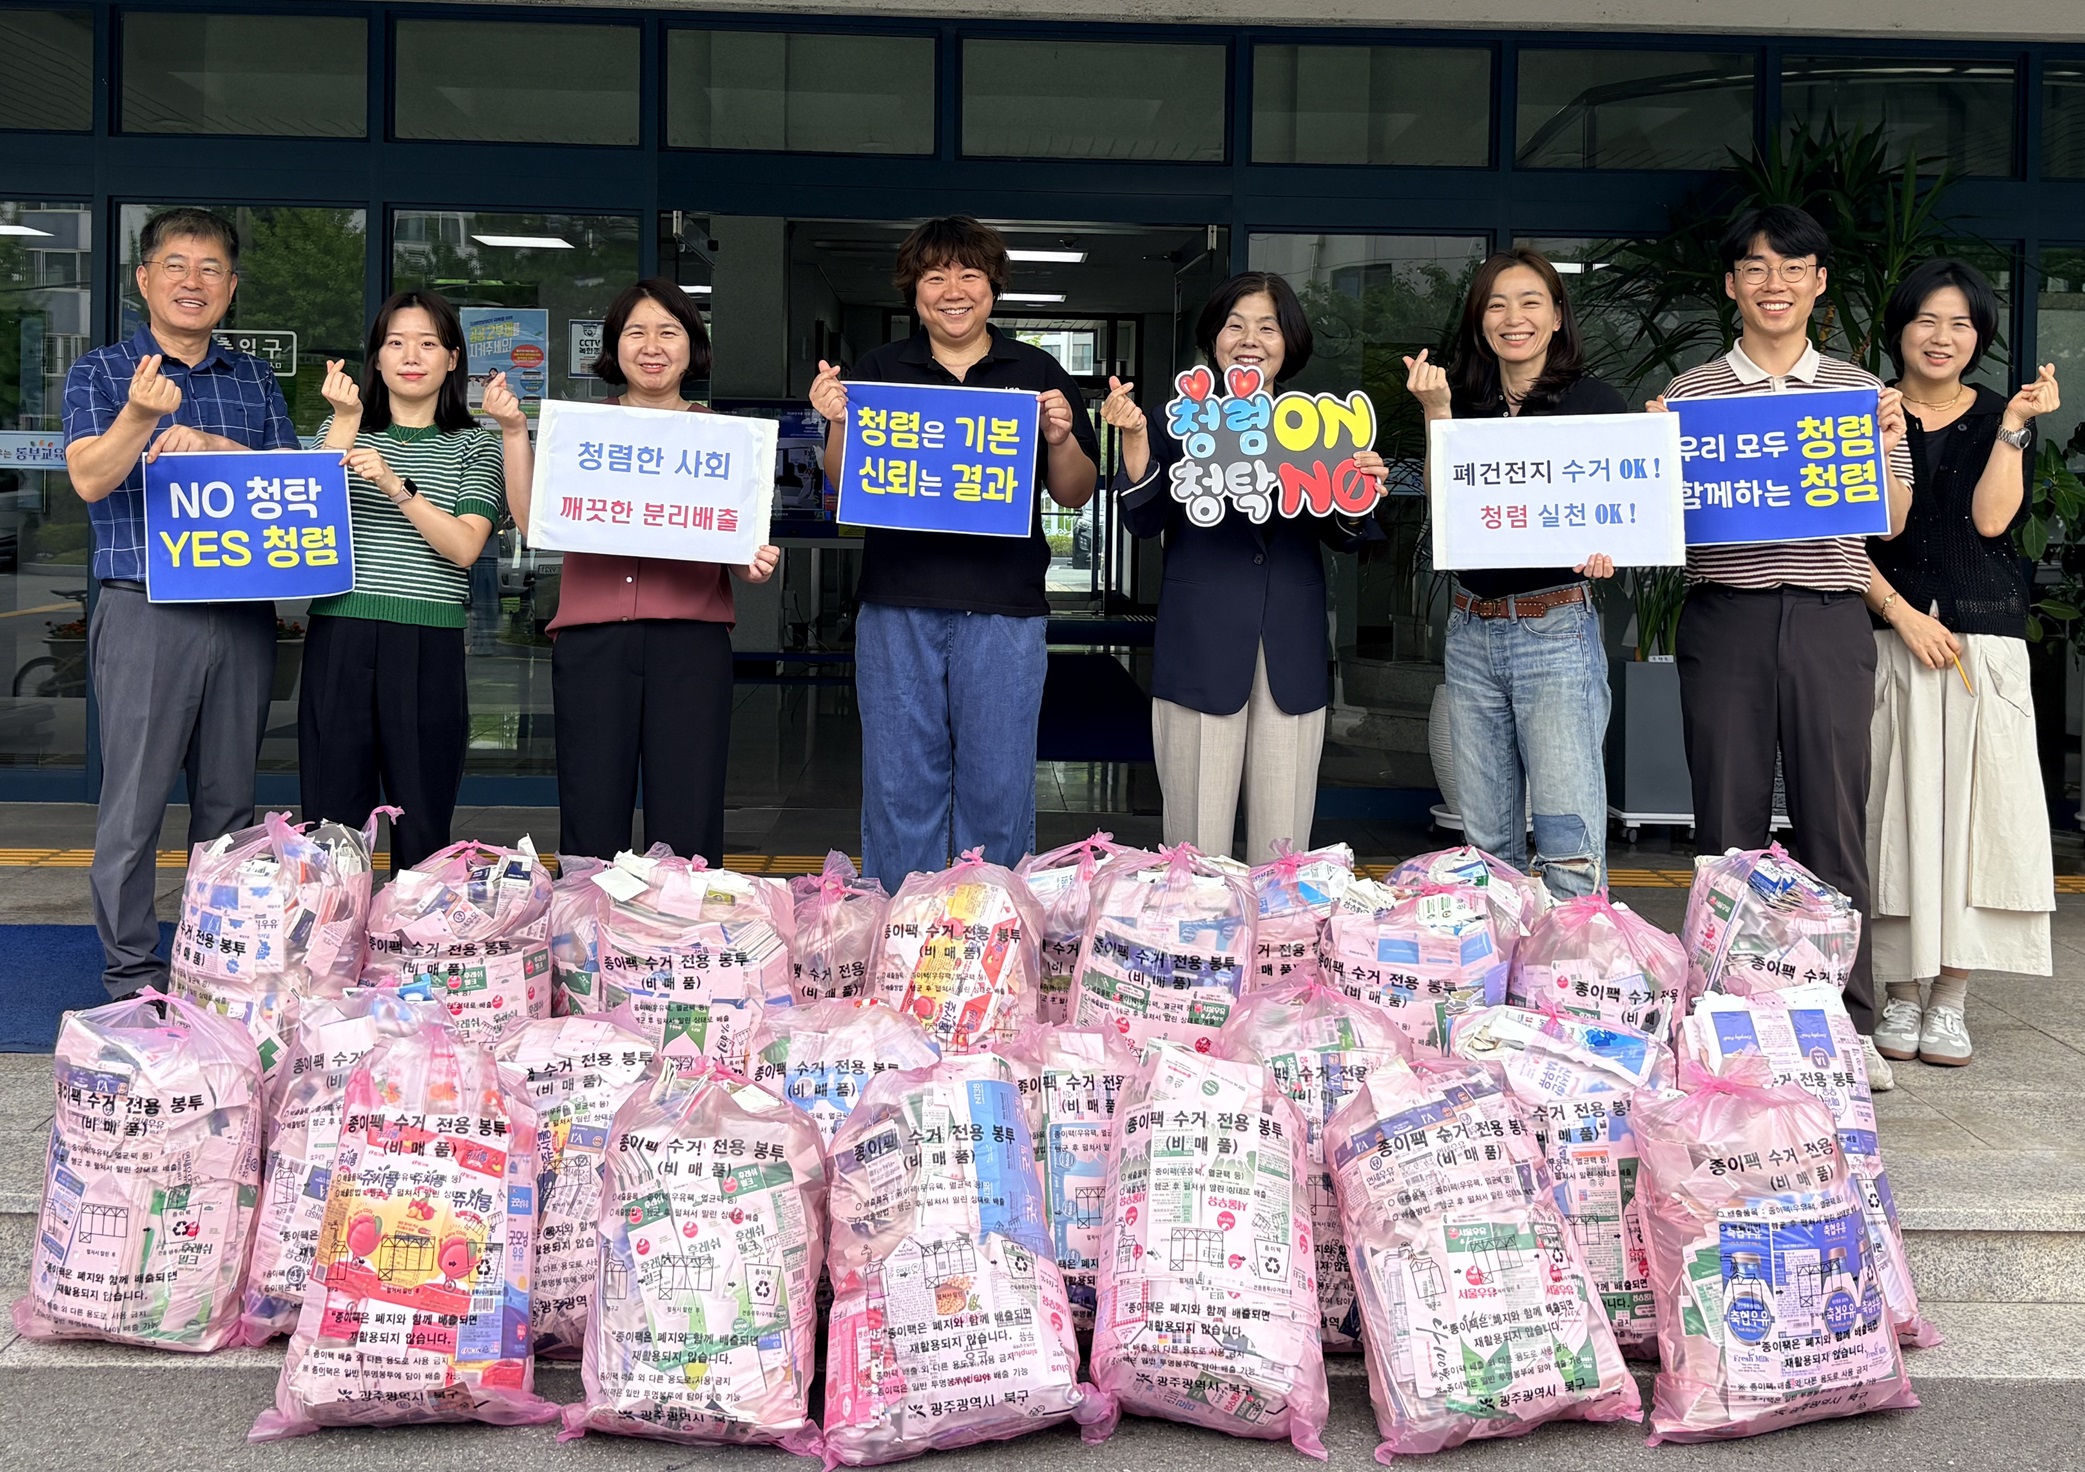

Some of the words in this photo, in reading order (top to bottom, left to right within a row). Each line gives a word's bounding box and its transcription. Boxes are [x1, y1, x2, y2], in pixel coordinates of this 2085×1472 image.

[858, 406, 946, 449] 청렴은
[955, 416, 1020, 456] 기본
[1680, 434, 1726, 462] 우리
[1735, 431, 1789, 459] 모두
[1796, 414, 1875, 459] 청렴
[577, 441, 664, 476] 청렴한
[674, 449, 731, 481] 사회
[858, 456, 943, 498] 신뢰는
[952, 463, 1018, 504] 결과
[1452, 459, 1552, 488] 폐건전지
[1561, 458, 1612, 484] 수거
[1799, 460, 1880, 508] 청렴
[169, 480, 235, 519] NO
[245, 475, 322, 520] 청탁
[559, 495, 634, 525] 깨끗한
[642, 502, 740, 533] 분리배출
[1479, 503, 1529, 530] 청렴
[1537, 502, 1587, 528] 실천
[159, 529, 253, 568] YES
[262, 524, 339, 568] 청렴
[925, 924, 955, 939] 수거
[196, 929, 214, 949] 전용
[220, 937, 246, 956] 봉투
[411, 941, 438, 956] 수거
[448, 943, 478, 956] 전용
[485, 941, 512, 954] 봉투
[1279, 944, 1305, 957] 전용
[604, 956, 638, 972] 종이팩
[645, 955, 673, 970] 수거
[681, 955, 711, 969] 전용
[719, 952, 750, 967] 봉투
[1135, 949, 1164, 969] 수거
[1173, 955, 1202, 971] 전용
[1209, 956, 1236, 971] 봉투
[1751, 955, 1796, 980] 종이팩
[1803, 969, 1831, 983] 수거
[809, 967, 833, 982] 수거
[839, 962, 865, 978] 전용
[1351, 966, 1380, 984] 수거
[1389, 972, 1419, 990] 전용
[1575, 981, 1620, 1003] 종이팩
[1628, 989, 1655, 1006] 수거
[293, 1052, 325, 1075] 종이팩
[544, 1058, 573, 1078] 수거
[581, 1052, 613, 1068] 전용
[622, 1051, 653, 1066] 봉투
[755, 1062, 787, 1081] 종이팩
[794, 1061, 825, 1076] 수거
[835, 1059, 866, 1075] 전용
[1018, 1075, 1056, 1095] 종이팩
[1066, 1074, 1095, 1091] 수거
[1800, 1072, 1826, 1088] 전용
[1833, 1072, 1856, 1088] 봉투
[87, 1093, 116, 1112] 수거
[126, 1097, 161, 1115] 전용
[170, 1095, 204, 1113] 봉투
[1533, 1105, 1567, 1123] 수거
[1574, 1102, 1606, 1118] 전용
[348, 1113, 385, 1133] 종이팩
[393, 1114, 426, 1132] 수거
[437, 1117, 471, 1135] 전용
[478, 1118, 507, 1137] 봉투
[1127, 1110, 1164, 1134] 종이팩
[1173, 1110, 1206, 1128] 수거
[1217, 1112, 1250, 1132] 전용
[1258, 1117, 1283, 1140] 봉투
[619, 1134, 658, 1152] 종이팩
[667, 1140, 702, 1156] 수거
[713, 1139, 746, 1156] 전용
[754, 1140, 784, 1162] 봉투
[854, 1133, 898, 1162] 종이팩
[908, 1126, 942, 1146] 수거
[952, 1124, 984, 1142] 전용
[992, 1125, 1016, 1145] 봉투
[1377, 1130, 1429, 1158] 종이팩
[1436, 1124, 1470, 1144] 수거
[1475, 1120, 1504, 1137] 전용
[1709, 1151, 1763, 1176] 종이팩
[1768, 1147, 1799, 1168] 수거
[1803, 1137, 1834, 1158] 전용
[737, 1168, 758, 1179] 후레쉬
[735, 1225, 765, 1241] 후레쉬
[77, 1270, 104, 1284] 폐지와
[1458, 1288, 1497, 1299] 서울우유
[1546, 1285, 1574, 1296] 서울우유
[375, 1313, 406, 1325] 폐지와
[412, 1313, 433, 1325] 함께
[933, 1316, 964, 1331] 폐지와
[969, 1313, 990, 1327] 함께
[1170, 1303, 1201, 1315] 폐지와
[1206, 1306, 1227, 1318] 함께
[1232, 1307, 1270, 1322] 배출되면
[1523, 1307, 1542, 1320] 함께
[1729, 1309, 1771, 1326] 축협우유
[1826, 1303, 1857, 1322] 축협우유
[350, 1331, 400, 1345] 재활용되지
[1145, 1321, 1195, 1334] 재활용되지
[657, 1332, 688, 1344] 폐지와
[693, 1333, 714, 1345] 함께
[719, 1334, 758, 1346] 배출되면
[909, 1337, 962, 1354] 재활용되지
[1474, 1333, 1522, 1348] 재활용되지
[1805, 1334, 1831, 1347] 폐지와
[632, 1350, 682, 1363] 재활용되지
[1733, 1354, 1753, 1363] Fresh
[1784, 1351, 1830, 1369] 재활용되지
[1157, 1375, 1220, 1393] 광주광역시
[1500, 1384, 1557, 1407] 광주광역시
[1564, 1377, 1586, 1393] 북구
[930, 1394, 995, 1416] 광주광역시
[1004, 1390, 1029, 1405] 북구
